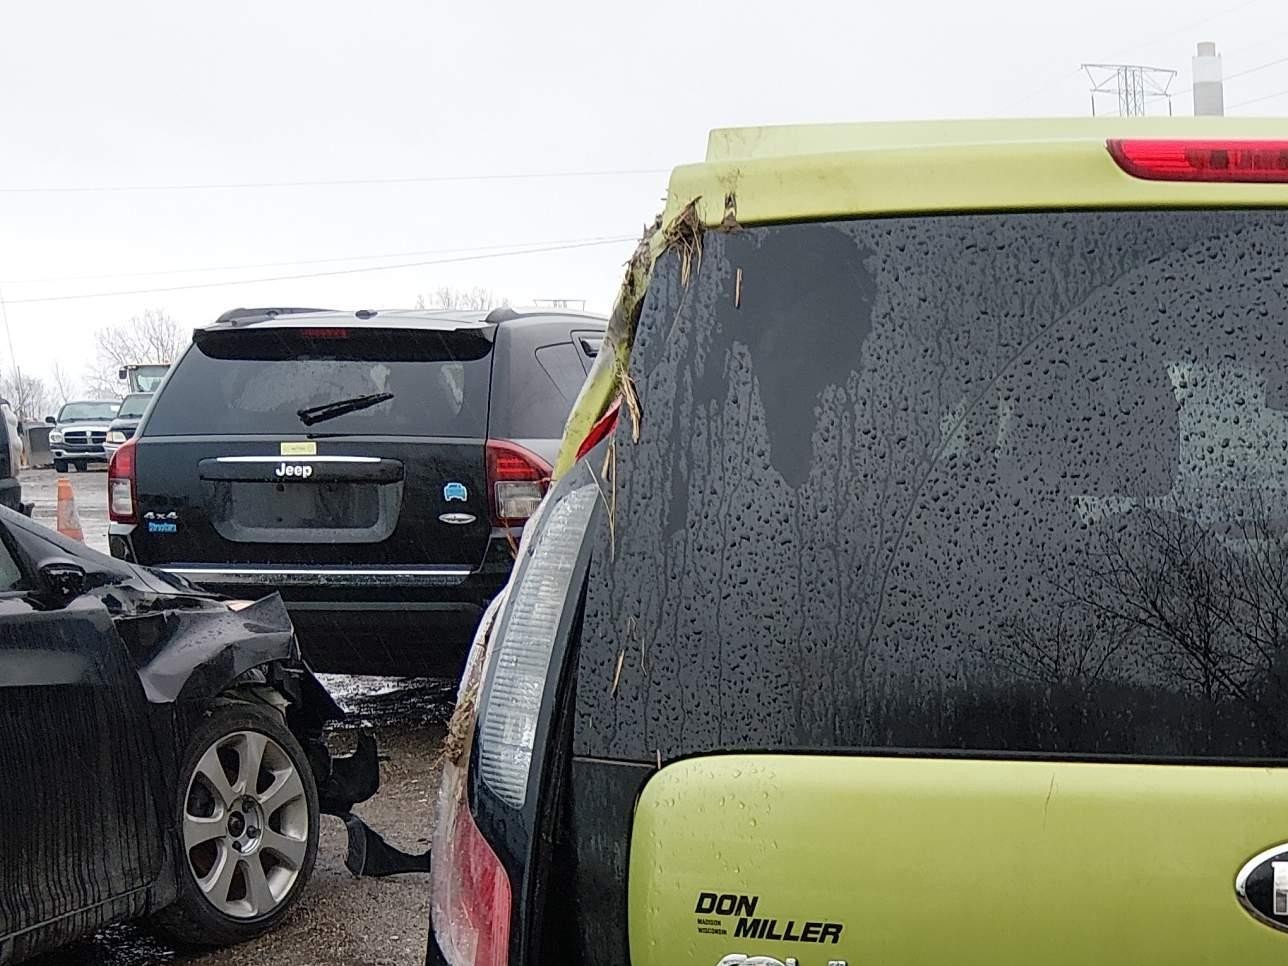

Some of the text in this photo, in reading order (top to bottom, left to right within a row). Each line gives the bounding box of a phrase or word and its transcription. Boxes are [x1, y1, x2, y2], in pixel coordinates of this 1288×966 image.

[275, 462, 313, 478] Jeep
[143, 511, 178, 520] 4x4
[695, 892, 759, 917] DON
[734, 917, 843, 944] MILLER
